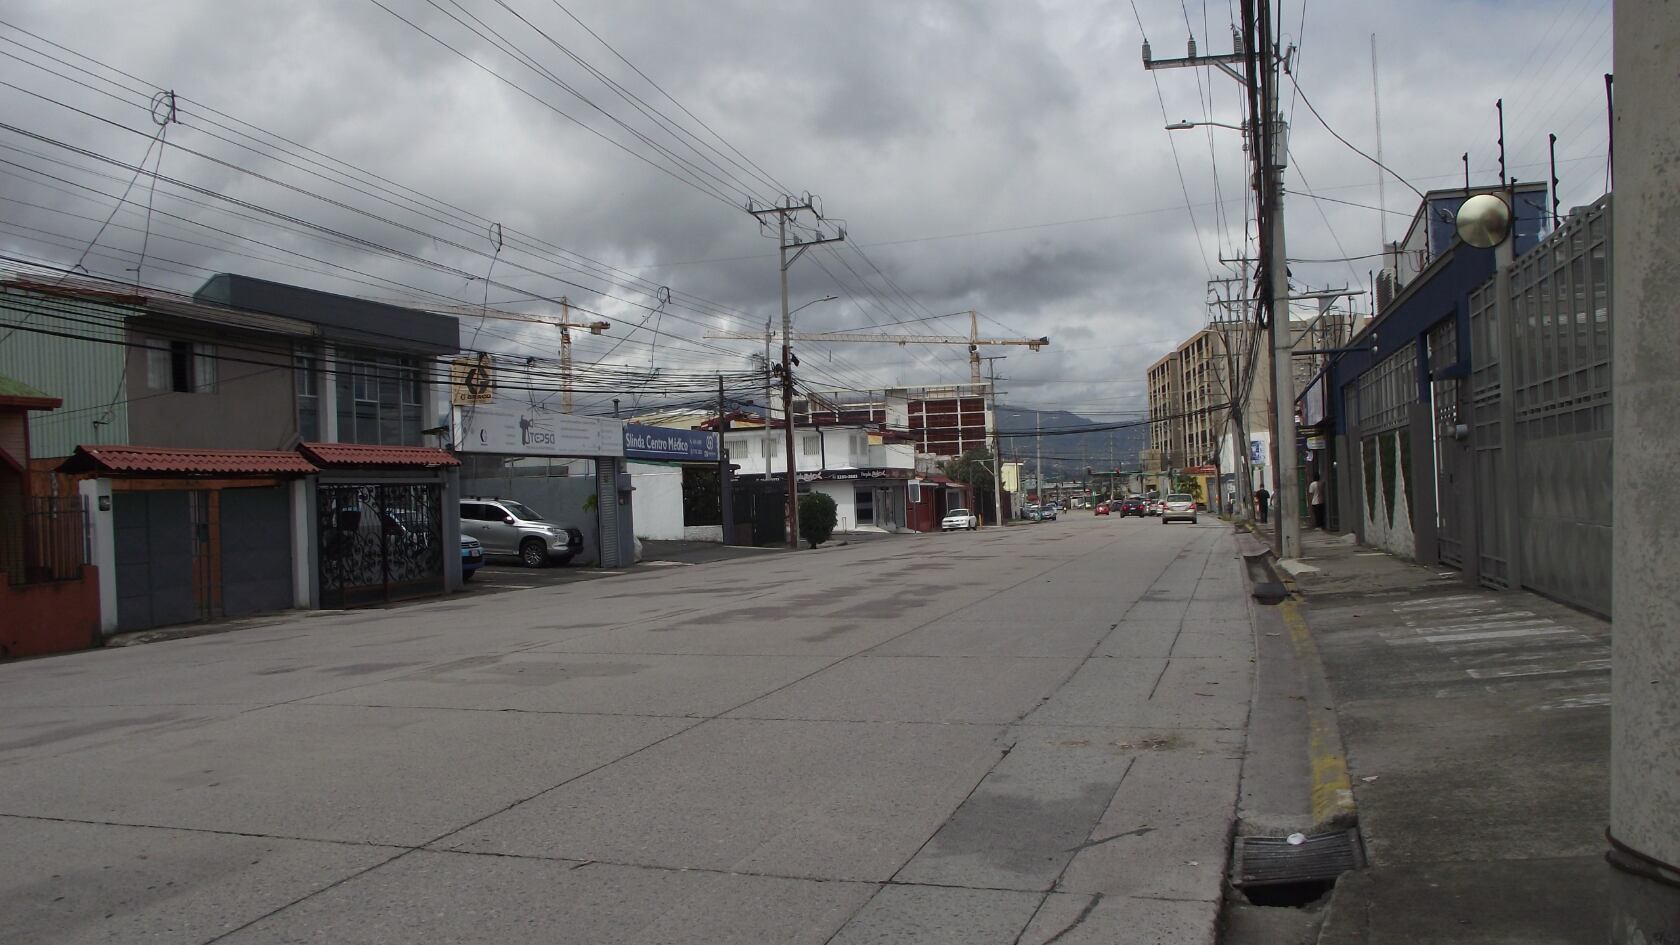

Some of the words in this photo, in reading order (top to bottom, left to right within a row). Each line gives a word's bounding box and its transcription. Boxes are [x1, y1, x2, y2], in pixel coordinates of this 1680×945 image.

[625, 433, 645, 448] Slinda
[646, 435, 667, 450] Centro
[668, 436, 689, 451] Médico
